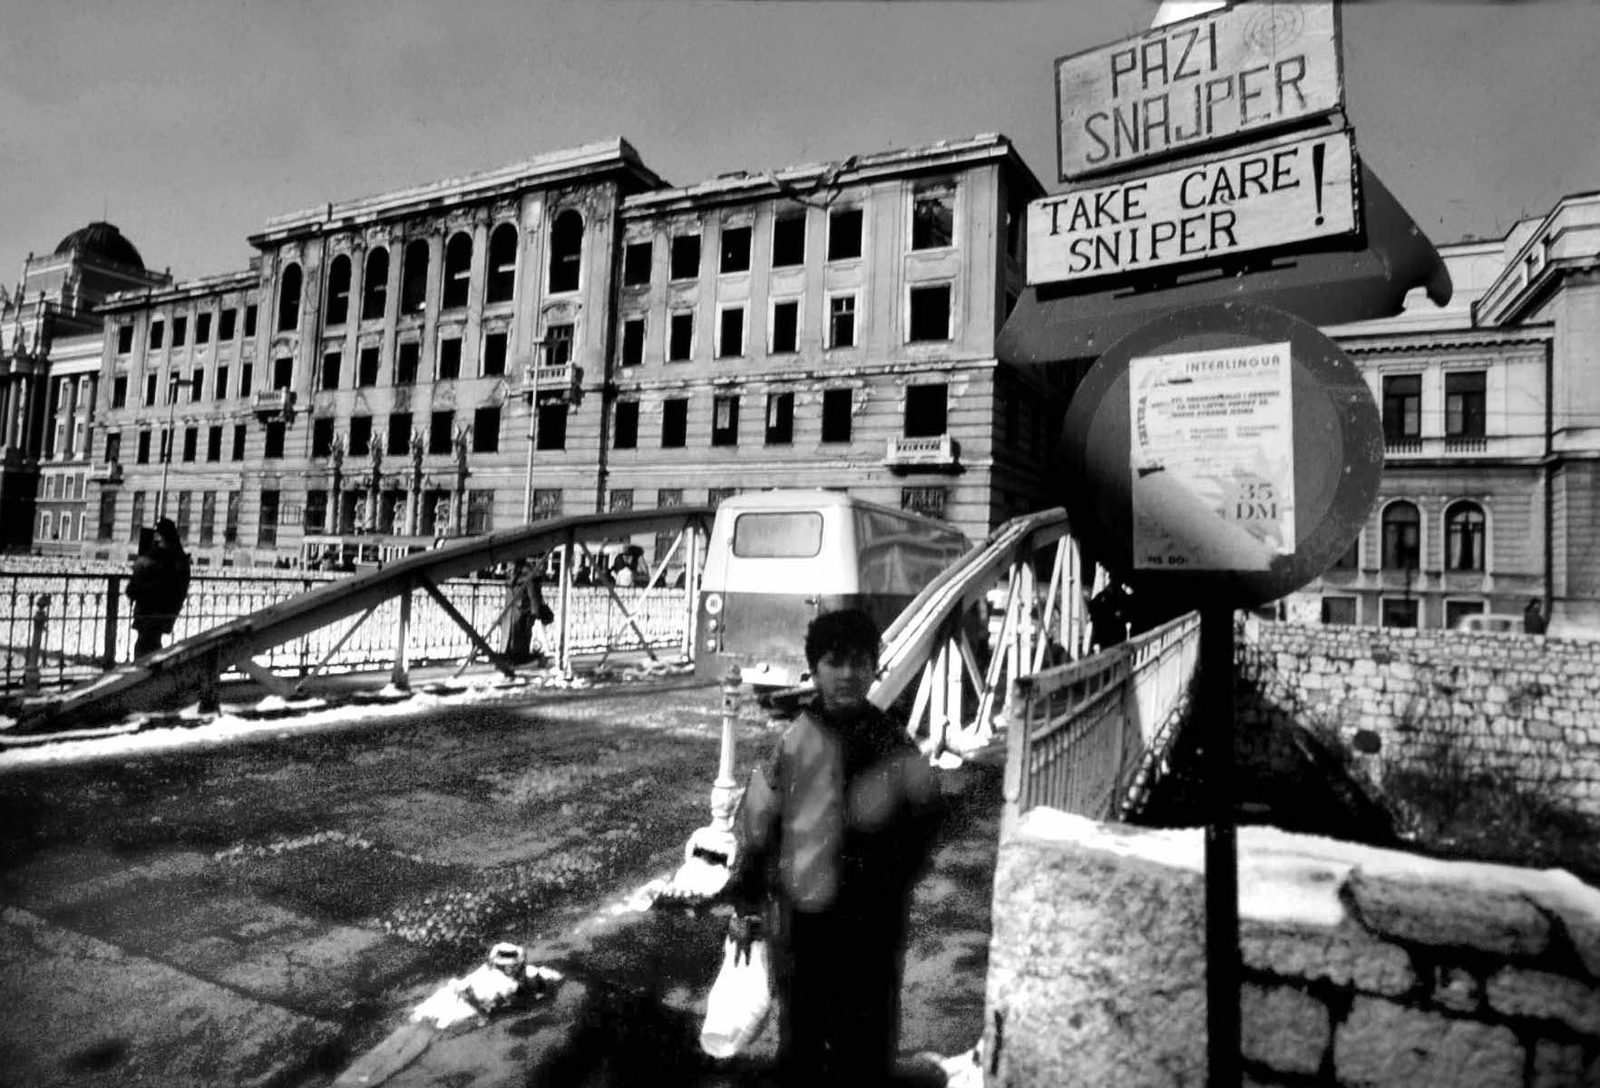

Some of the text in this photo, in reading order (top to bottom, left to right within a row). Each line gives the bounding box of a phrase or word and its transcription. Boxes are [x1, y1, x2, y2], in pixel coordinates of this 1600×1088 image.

[1111, 22, 1218, 98] PAZI
[1084, 55, 1307, 164] SNAJPER
[1042, 182, 1148, 236] TAKE
[1068, 210, 1239, 274] SNIPER
[1236, 503, 1277, 520] DM
[1240, 483, 1273, 500] 35
